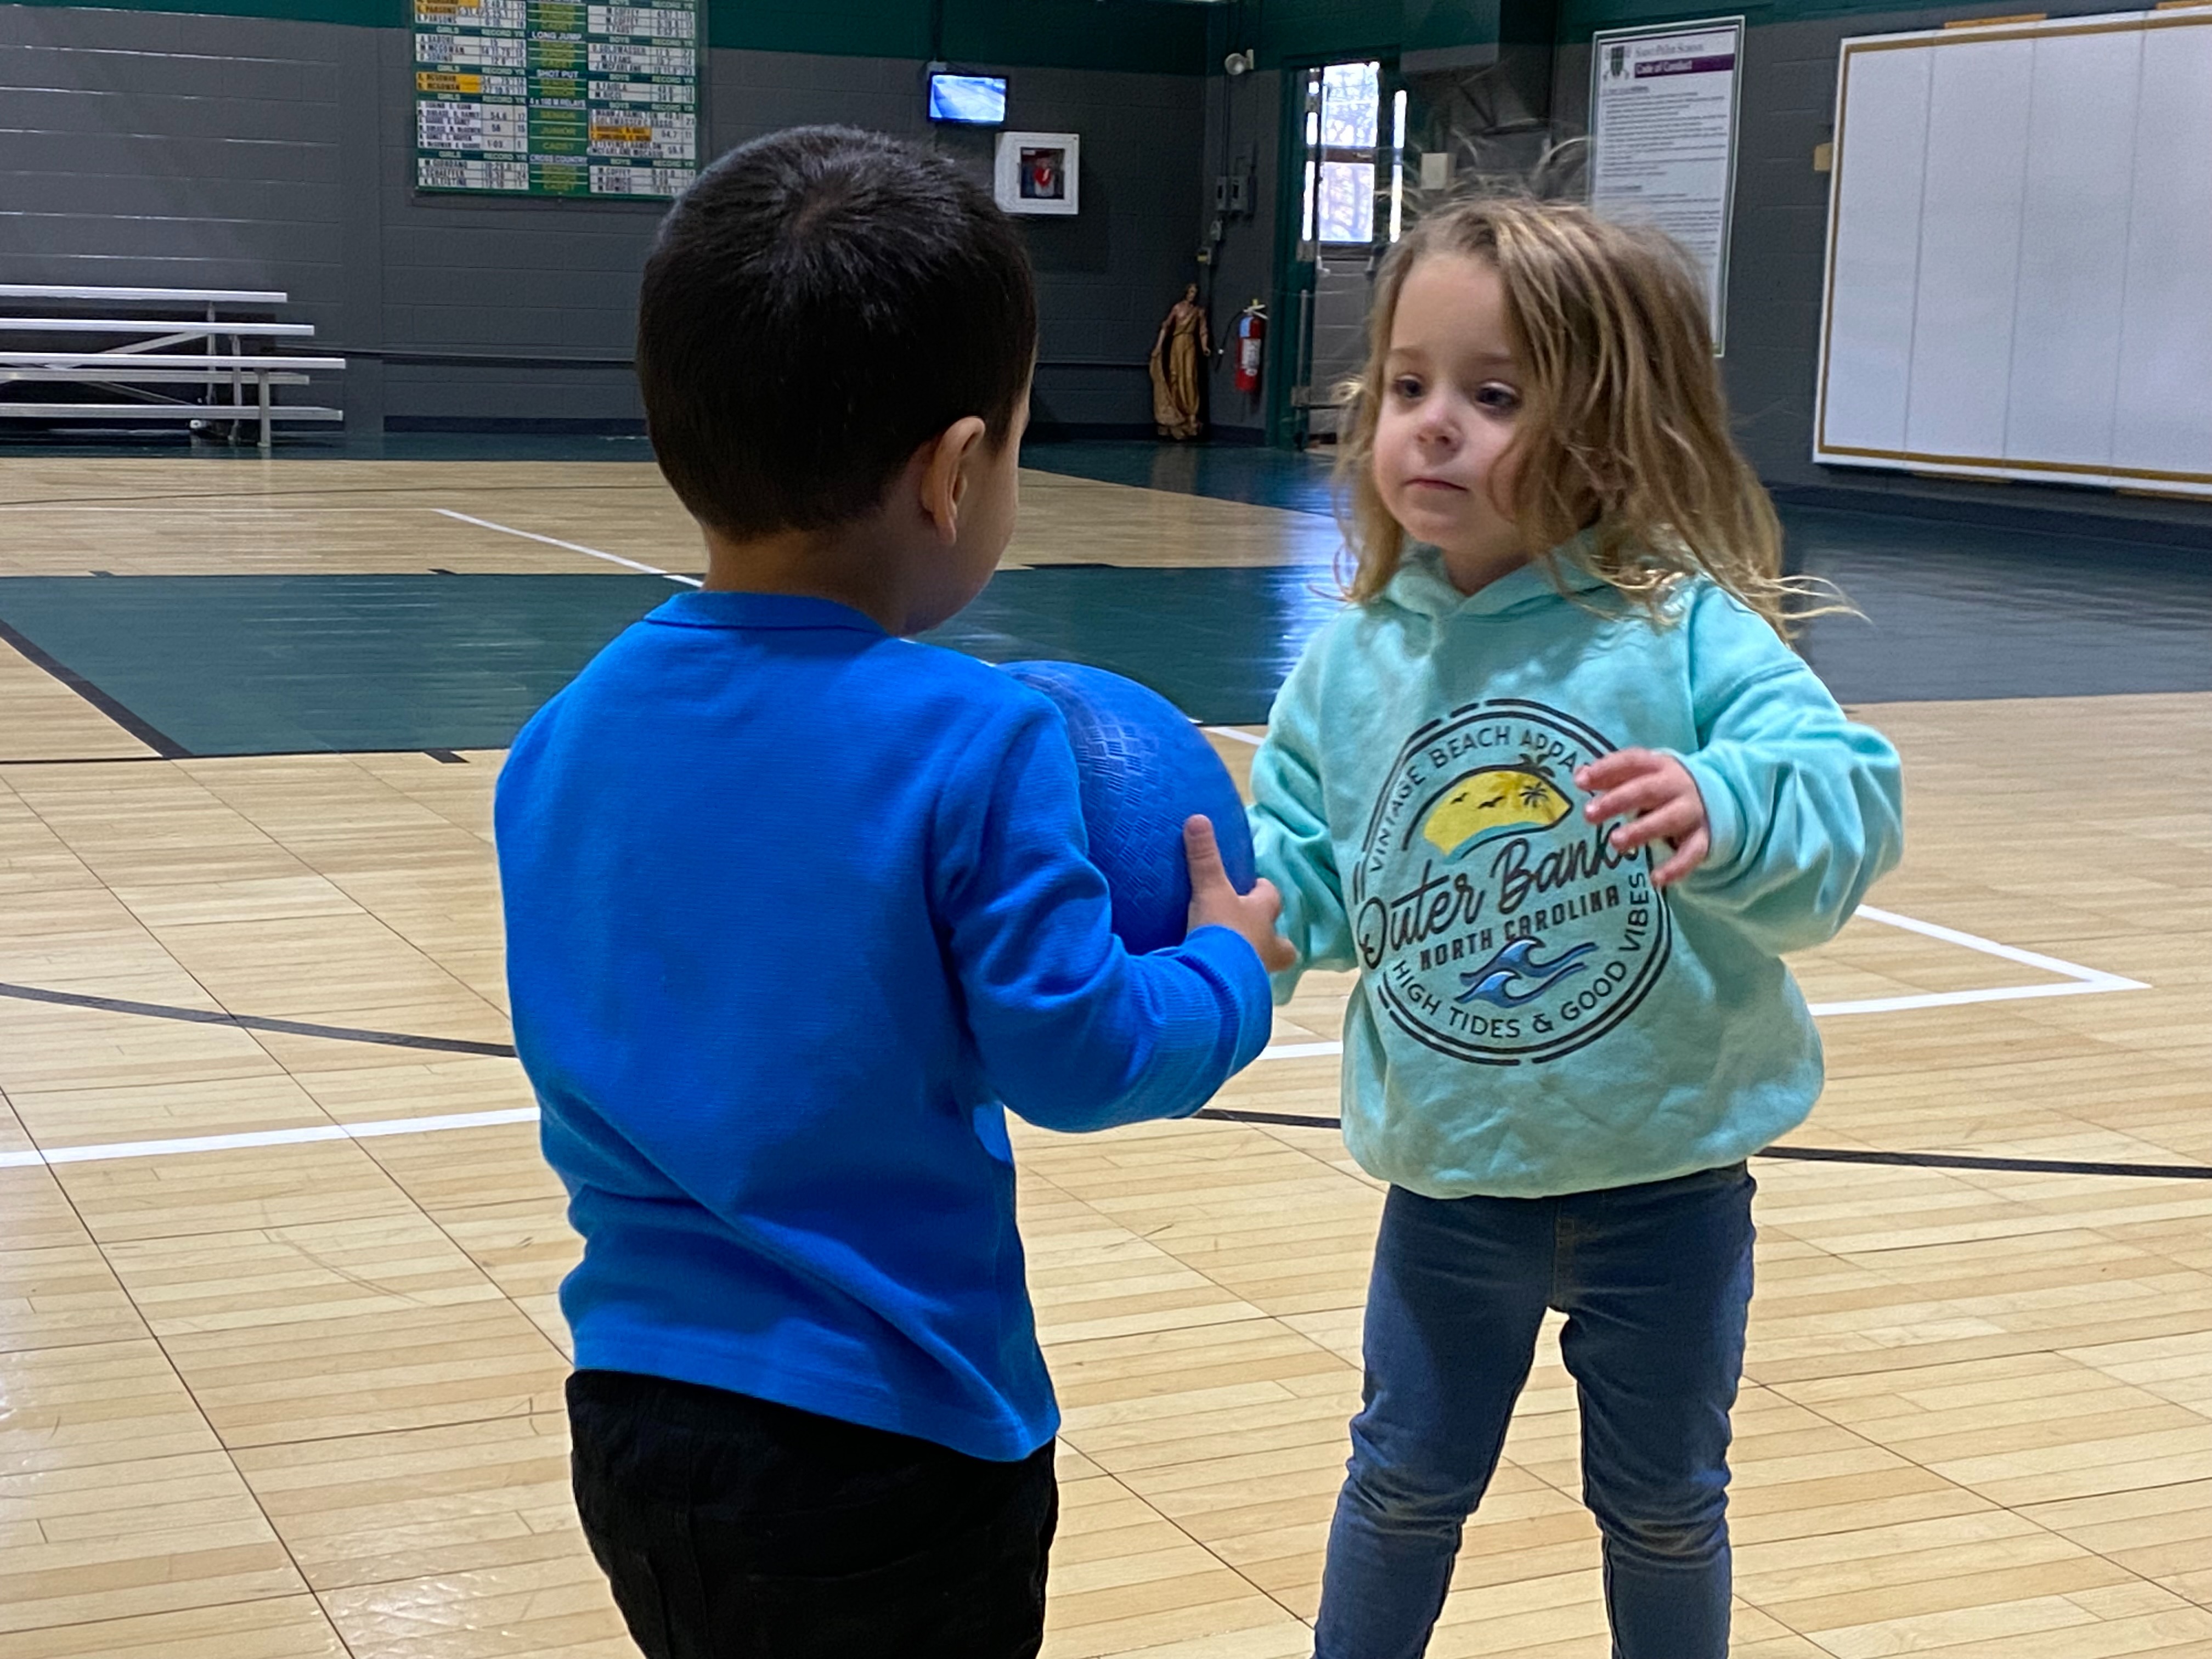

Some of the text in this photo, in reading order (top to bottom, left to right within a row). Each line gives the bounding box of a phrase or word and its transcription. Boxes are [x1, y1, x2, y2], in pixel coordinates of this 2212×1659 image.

[481, 29, 511, 37] RECORD
[532, 31, 556, 40] LONG
[537, 69, 559, 77] SHOT
[1637, 60, 1693, 74] Code of Conduct
[1370, 766, 1425, 872] VINTAGE
[1429, 725, 1510, 768] BEACH
[1357, 859, 1485, 969] Outer
[1420, 885, 1620, 972] NORTH CAROLINA
[1393, 872, 1649, 1038] HIGH TIDES & GOOD VIBES
